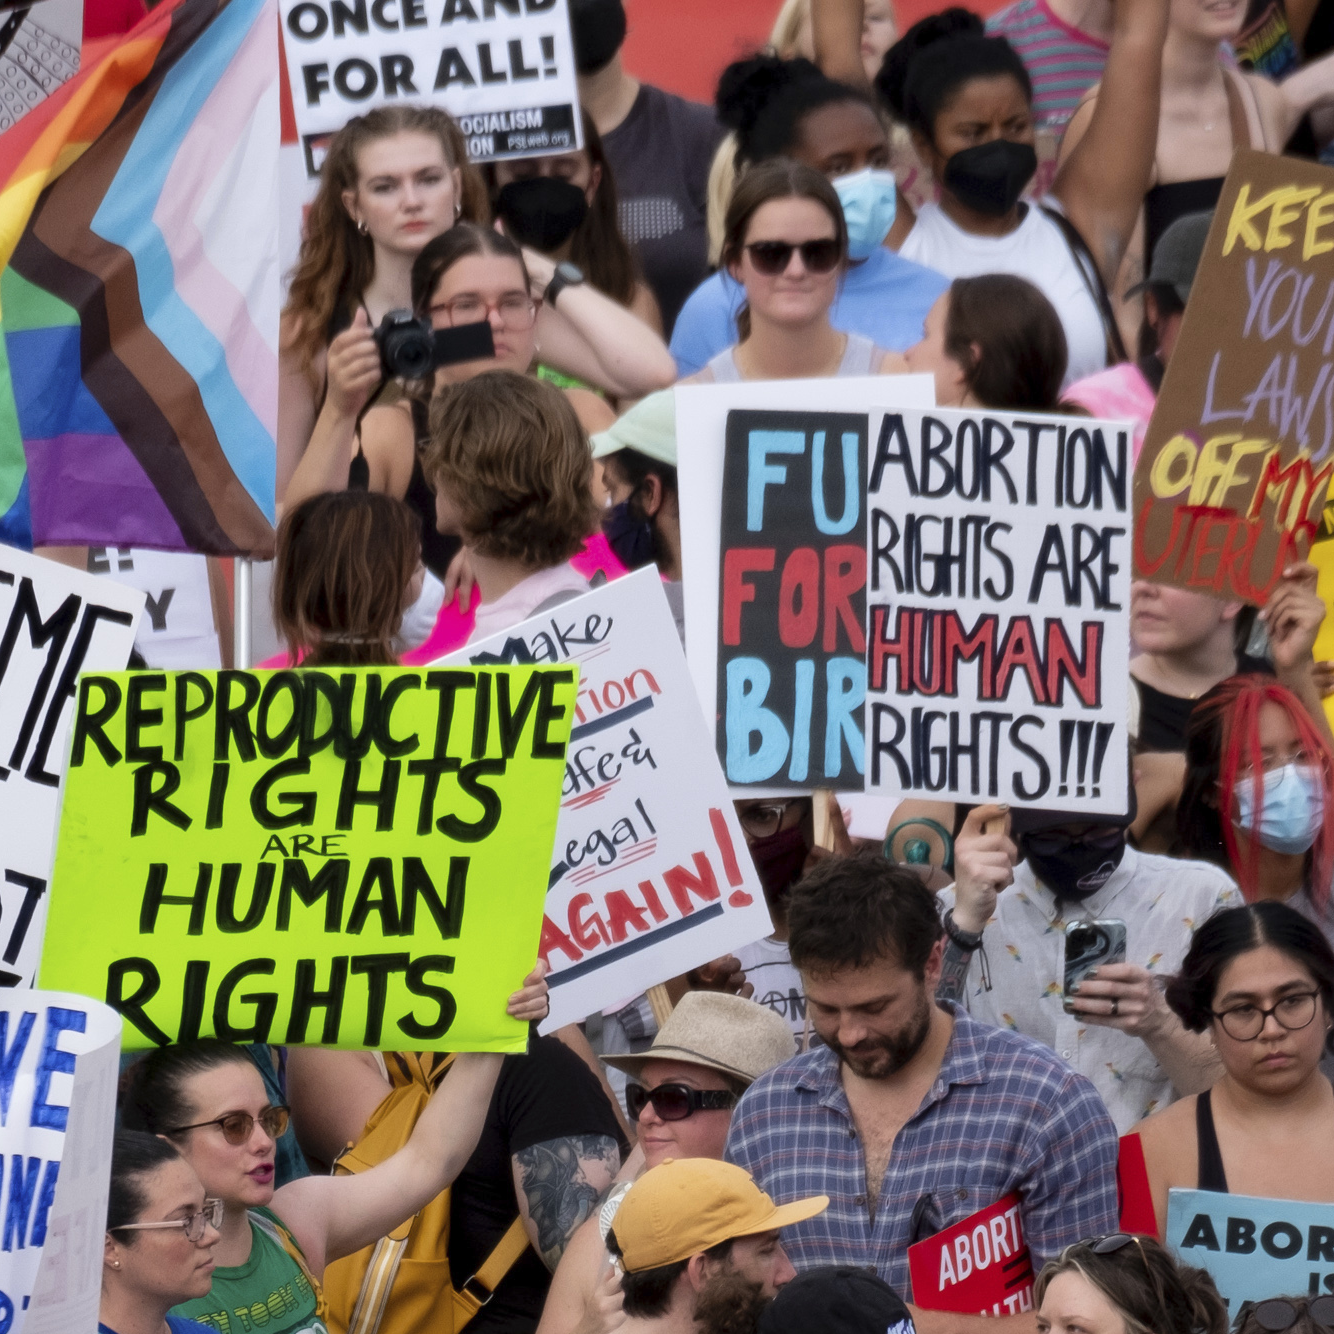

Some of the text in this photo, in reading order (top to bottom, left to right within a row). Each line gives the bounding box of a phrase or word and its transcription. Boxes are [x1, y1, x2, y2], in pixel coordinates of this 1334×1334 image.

[287, 0, 428, 42] ONCE
[302, 35, 558, 107] FOR ALL!
[462, 109, 543, 135] OCIALISM
[868, 413, 1128, 512] ABORTION
[1149, 434, 1271, 509] OFF
[868, 507, 1125, 611] RIGHTS ARE
[868, 605, 1104, 708] HUMAN
[70, 668, 575, 769] REPRODUCTIVE
[130, 754, 503, 844] RIGHTS
[261, 834, 348, 859] ARE
[139, 855, 471, 940] HUMAN
[105, 952, 459, 1047] RIGHTS
